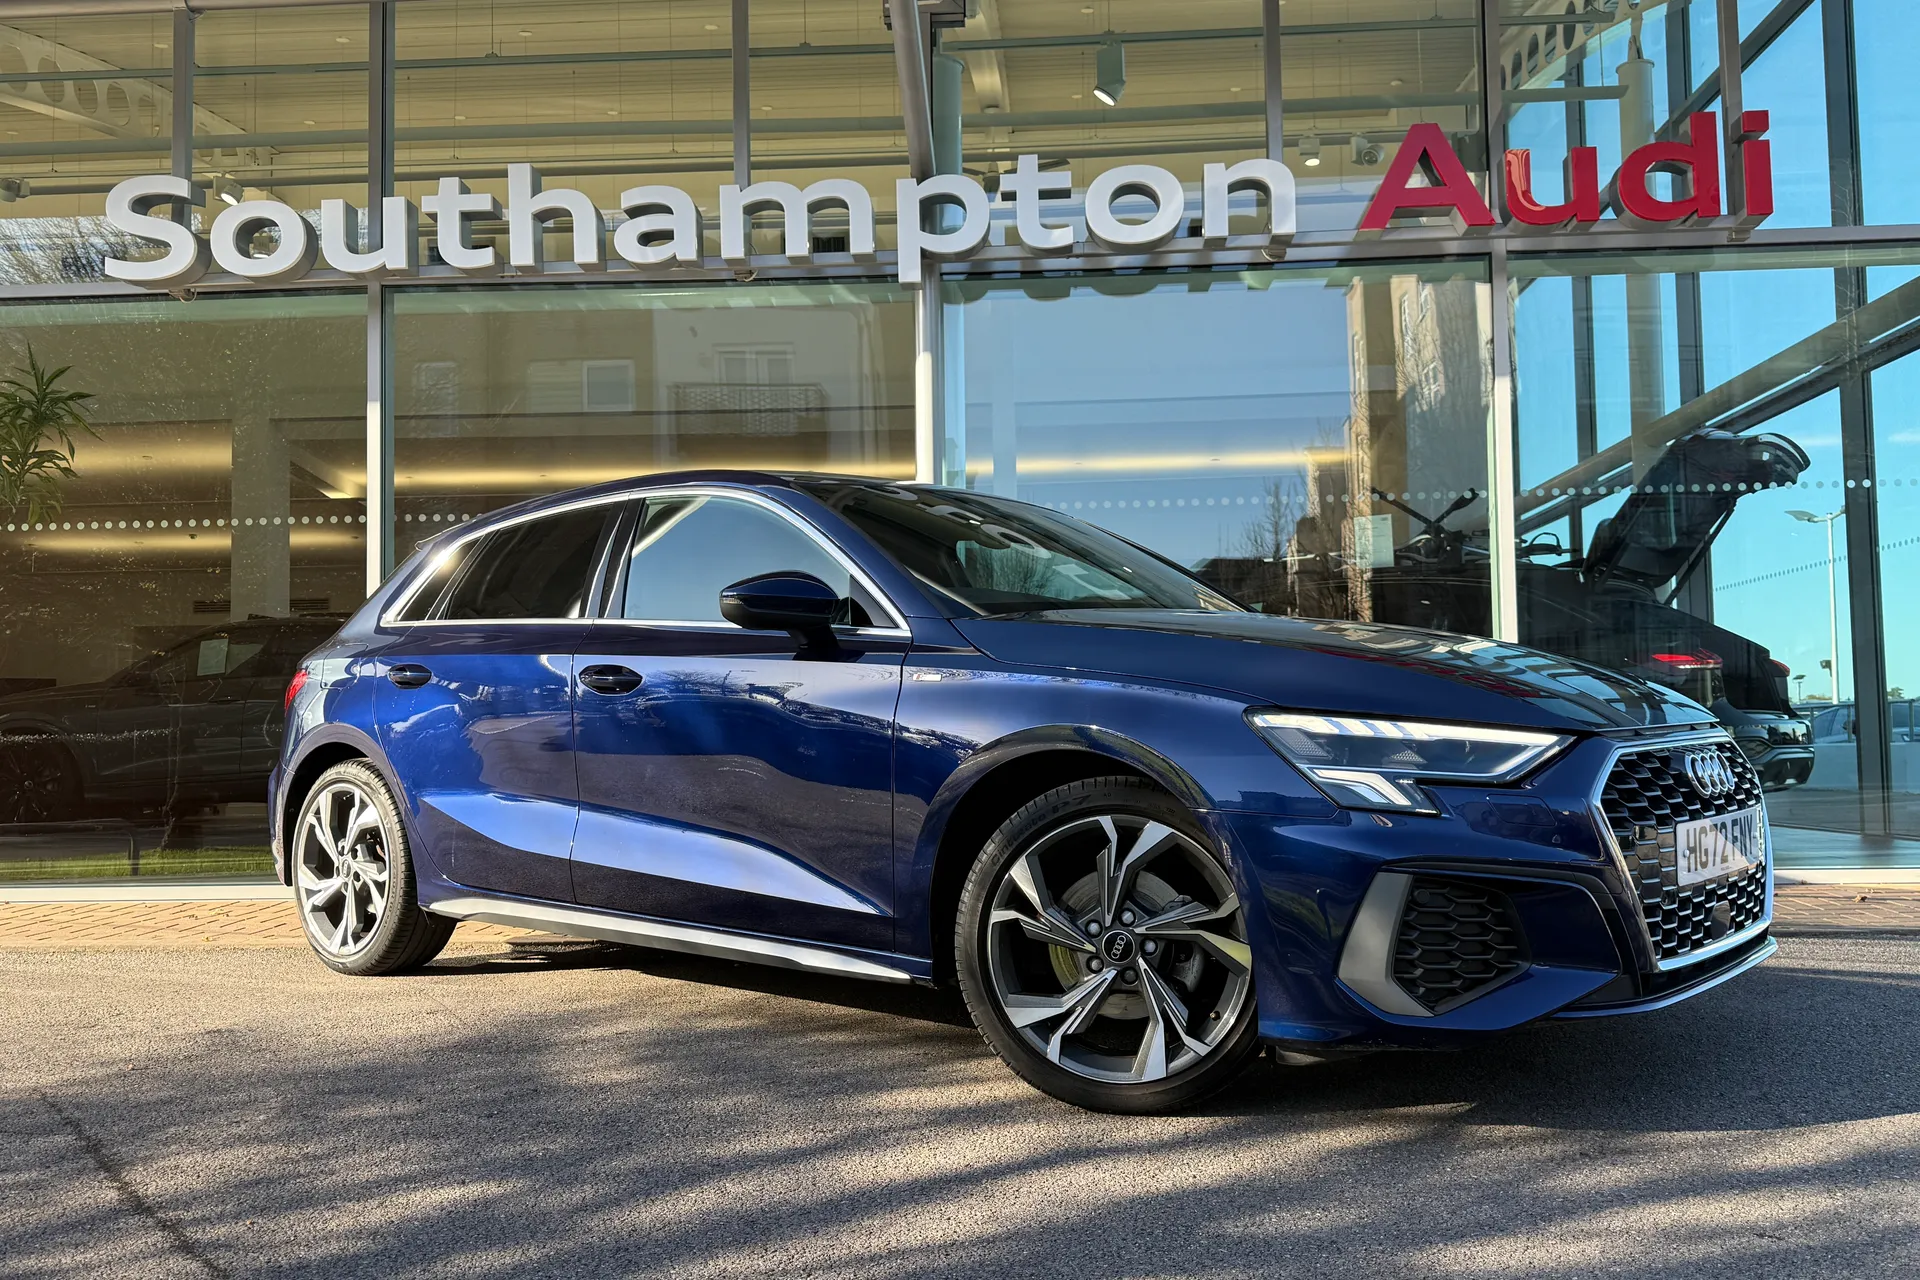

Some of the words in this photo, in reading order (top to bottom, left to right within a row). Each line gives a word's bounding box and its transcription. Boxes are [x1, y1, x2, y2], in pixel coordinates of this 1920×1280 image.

[102, 153, 1297, 285] Southampton
[1358, 110, 1774, 235] Audi
[1686, 821, 1728, 873] HG72
[1731, 814, 1753, 861] FNY
